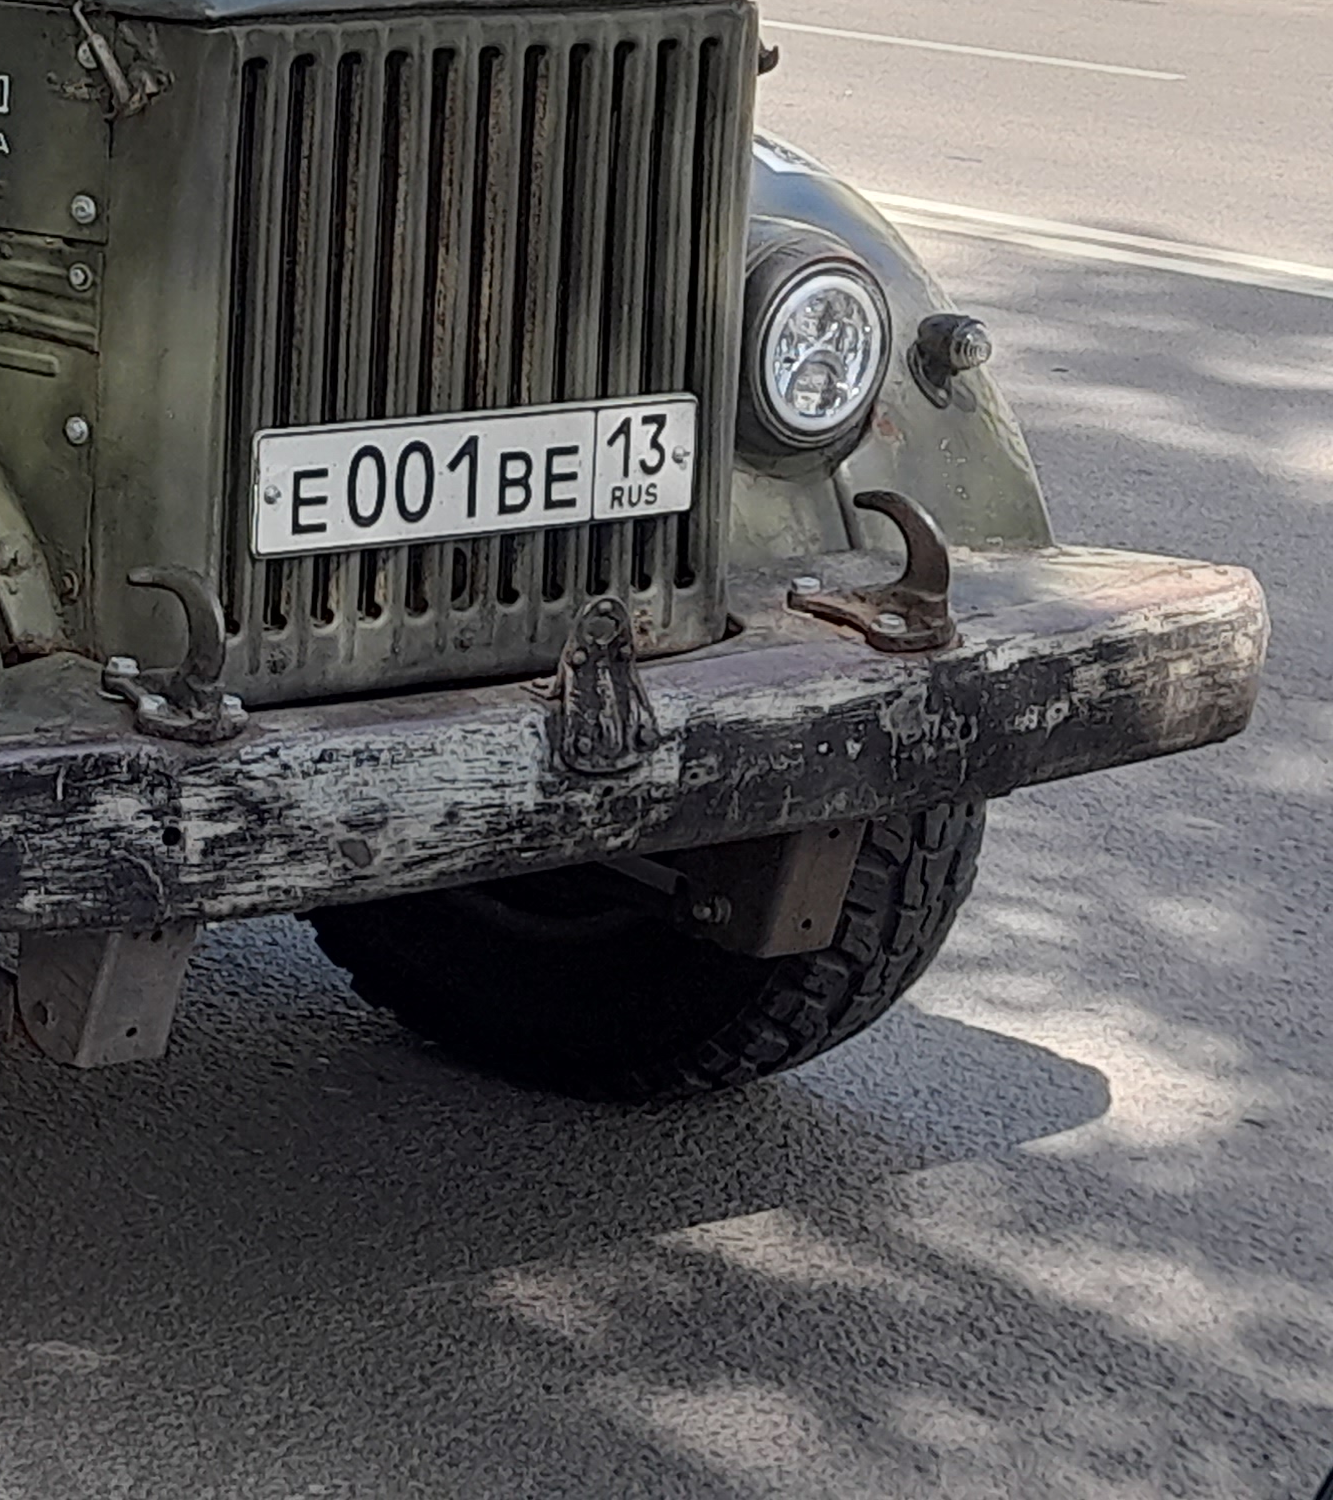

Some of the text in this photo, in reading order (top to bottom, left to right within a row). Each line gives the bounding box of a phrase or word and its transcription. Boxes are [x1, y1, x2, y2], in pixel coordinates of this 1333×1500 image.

[291, 413, 668, 536] Е001ВЕ 13
[609, 483, 659, 511] RUS
